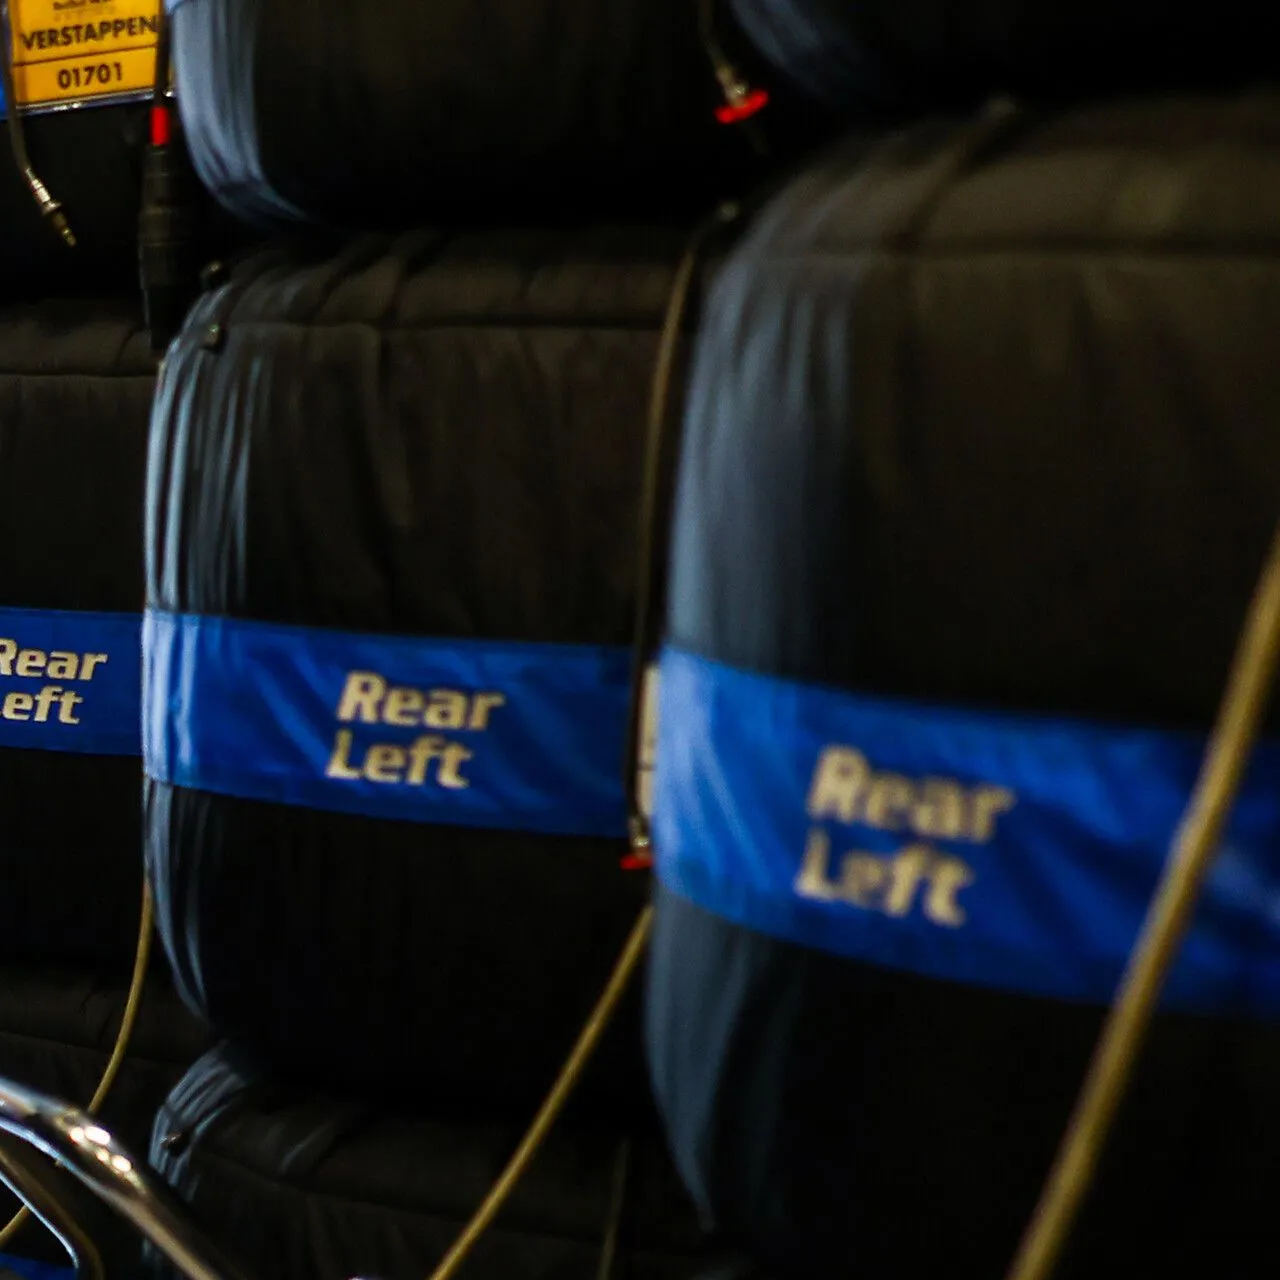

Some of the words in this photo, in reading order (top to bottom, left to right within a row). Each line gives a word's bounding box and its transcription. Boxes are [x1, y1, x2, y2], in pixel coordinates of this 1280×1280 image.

[19, 15, 159, 50] VERSTAPPEN
[57, 62, 122, 90] 01701
[336, 669, 506, 732] Rear
[324, 728, 472, 790] Left
[806, 743, 1018, 844] Rear
[793, 826, 974, 927] Left
